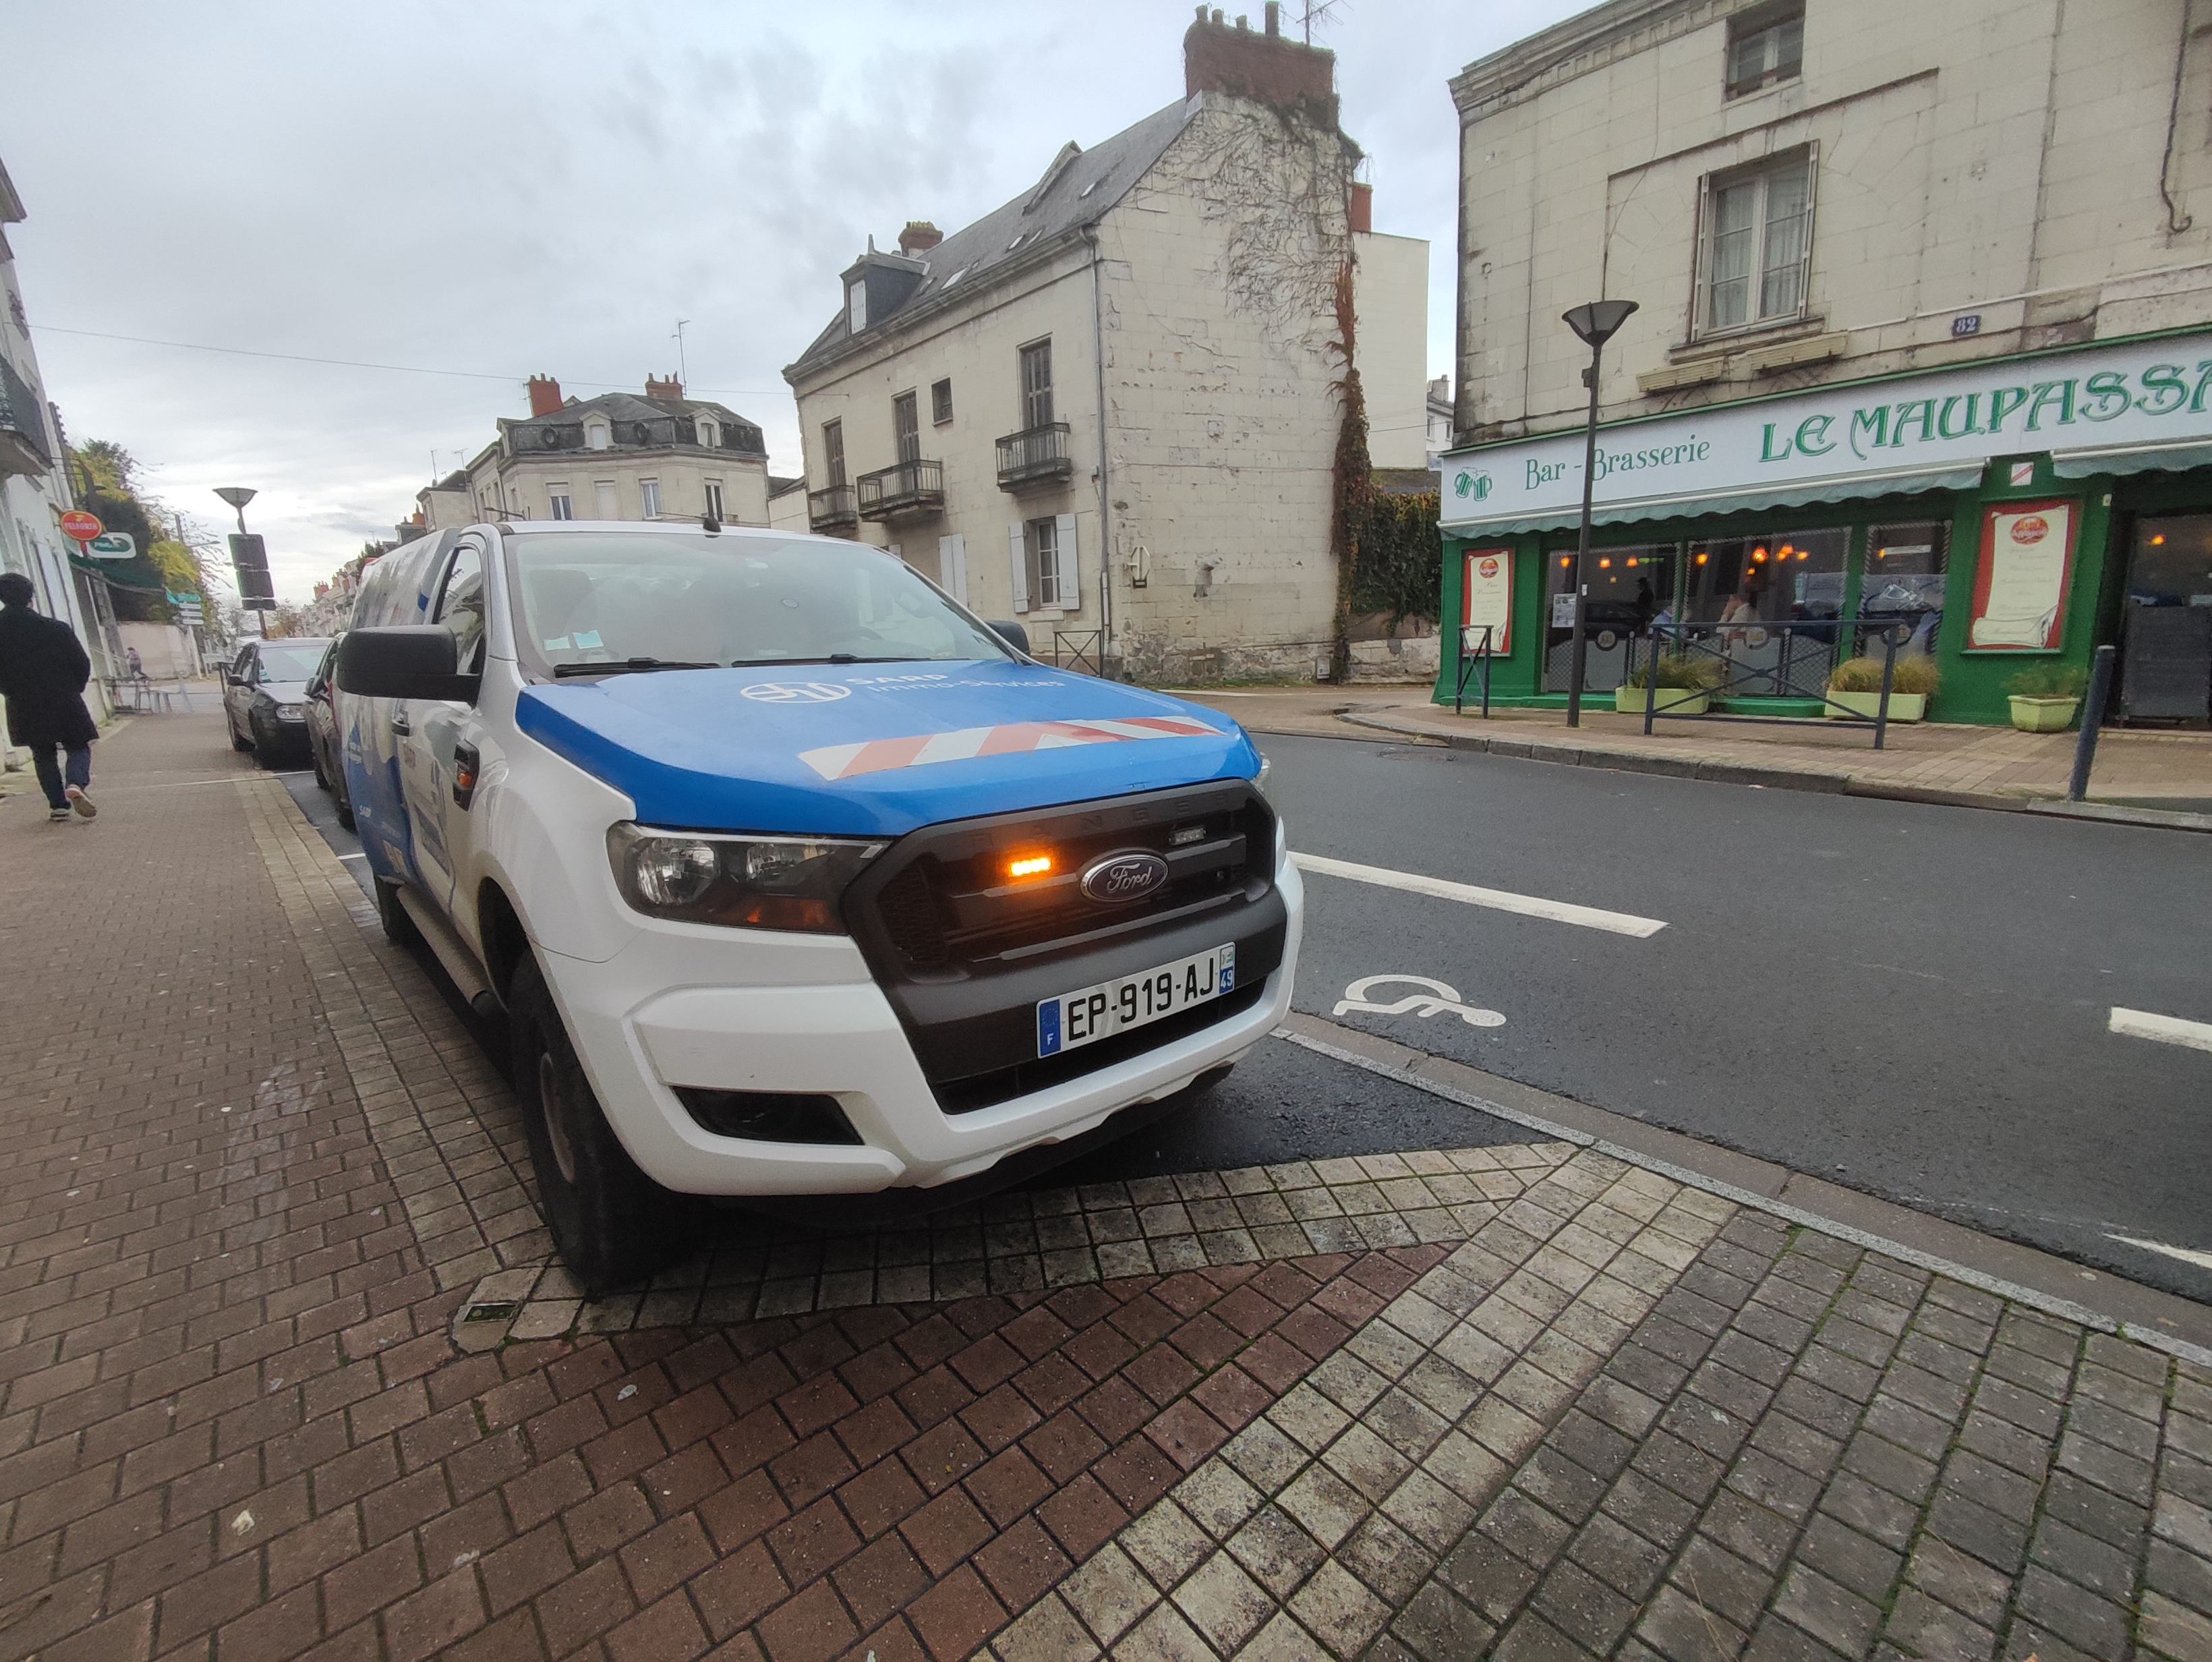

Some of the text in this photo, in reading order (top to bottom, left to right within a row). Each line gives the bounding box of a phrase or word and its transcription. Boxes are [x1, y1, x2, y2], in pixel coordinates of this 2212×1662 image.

[1956, 317, 1976, 333] 82
[1758, 414, 1838, 463] LE
[1525, 459, 1566, 490] Bar
[1592, 434, 1710, 481] Brasserie
[845, 675, 948, 685] SARP
[867, 680, 1066, 692] Immo-Services
[1106, 863, 1153, 894] Ford
[1047, 958, 1233, 1046] F EP-919-AJ 49
